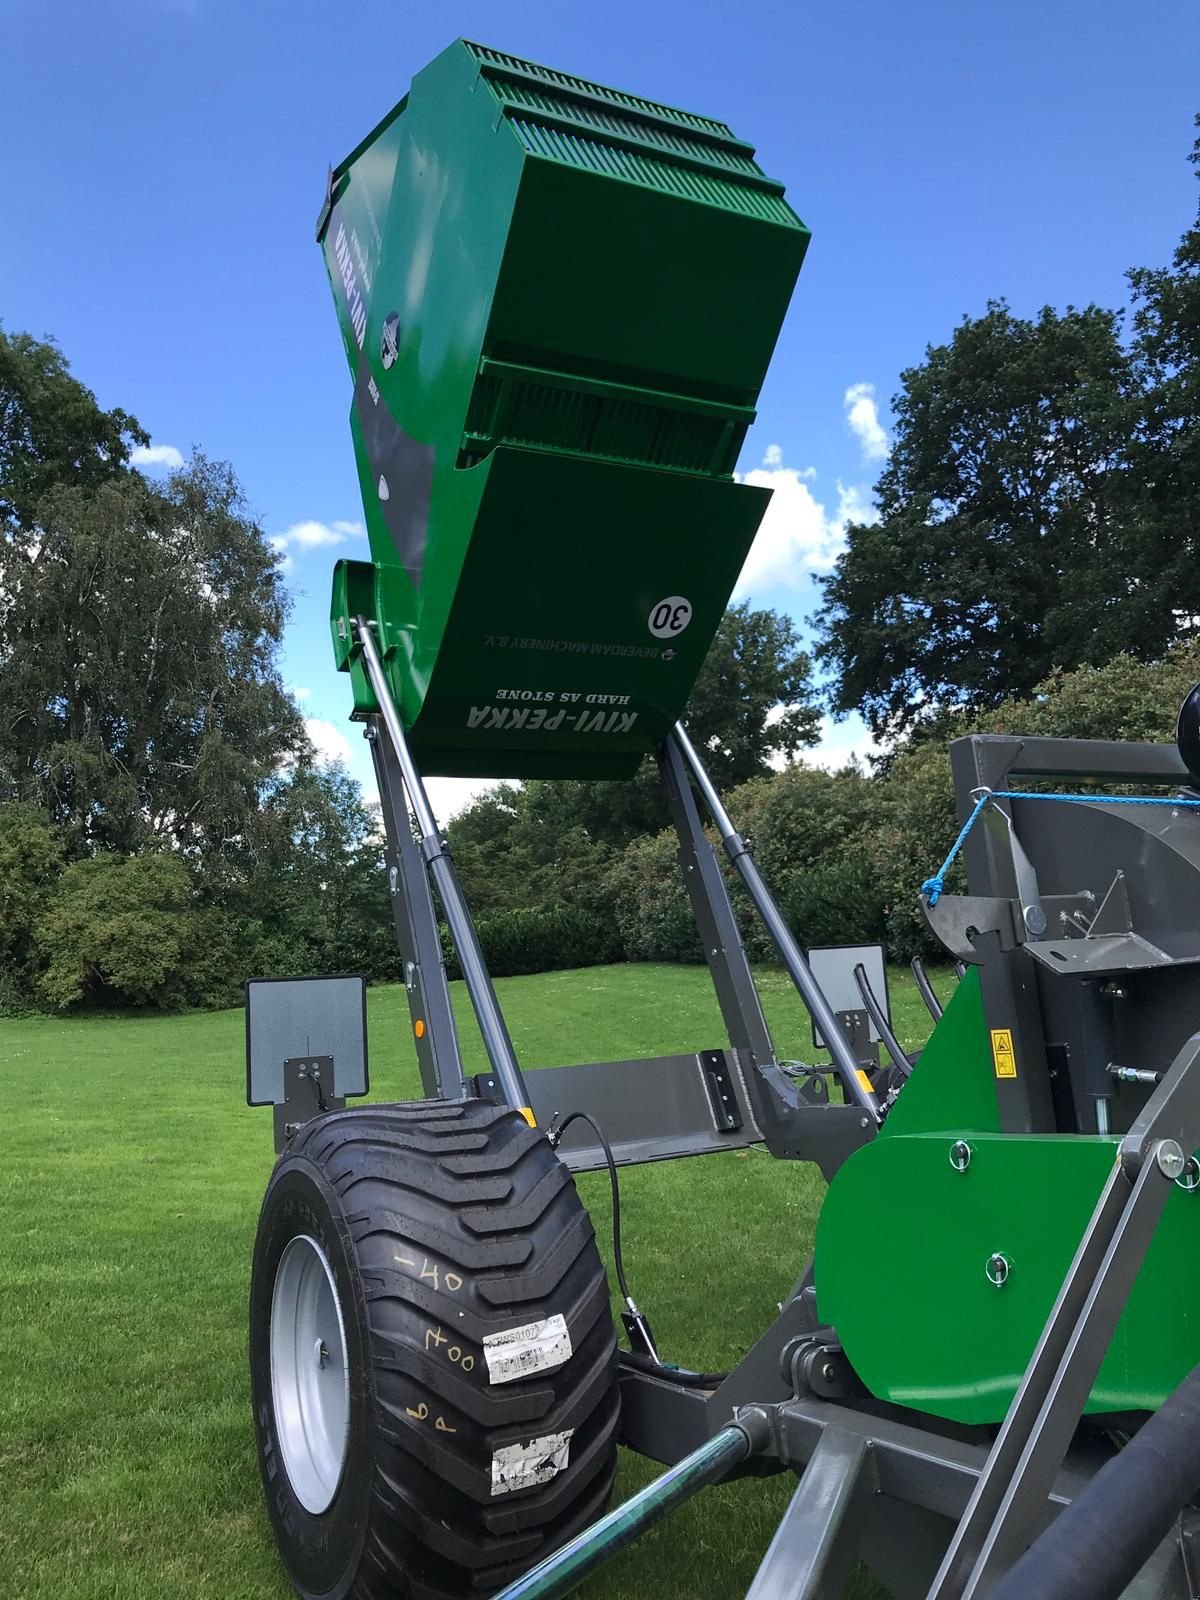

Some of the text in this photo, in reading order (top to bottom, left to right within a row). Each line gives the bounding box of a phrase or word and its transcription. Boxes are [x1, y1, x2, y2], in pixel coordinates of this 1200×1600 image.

[335, 222, 368, 351] KIVI-PEKKA
[652, 603, 689, 631] 30
[512, 637, 589, 655] MACHINERY
[589, 643, 659, 659] BEVERDAM
[495, 688, 631, 706] HARD AS STONE
[465, 705, 639, 734] KIVI-PEKKA
